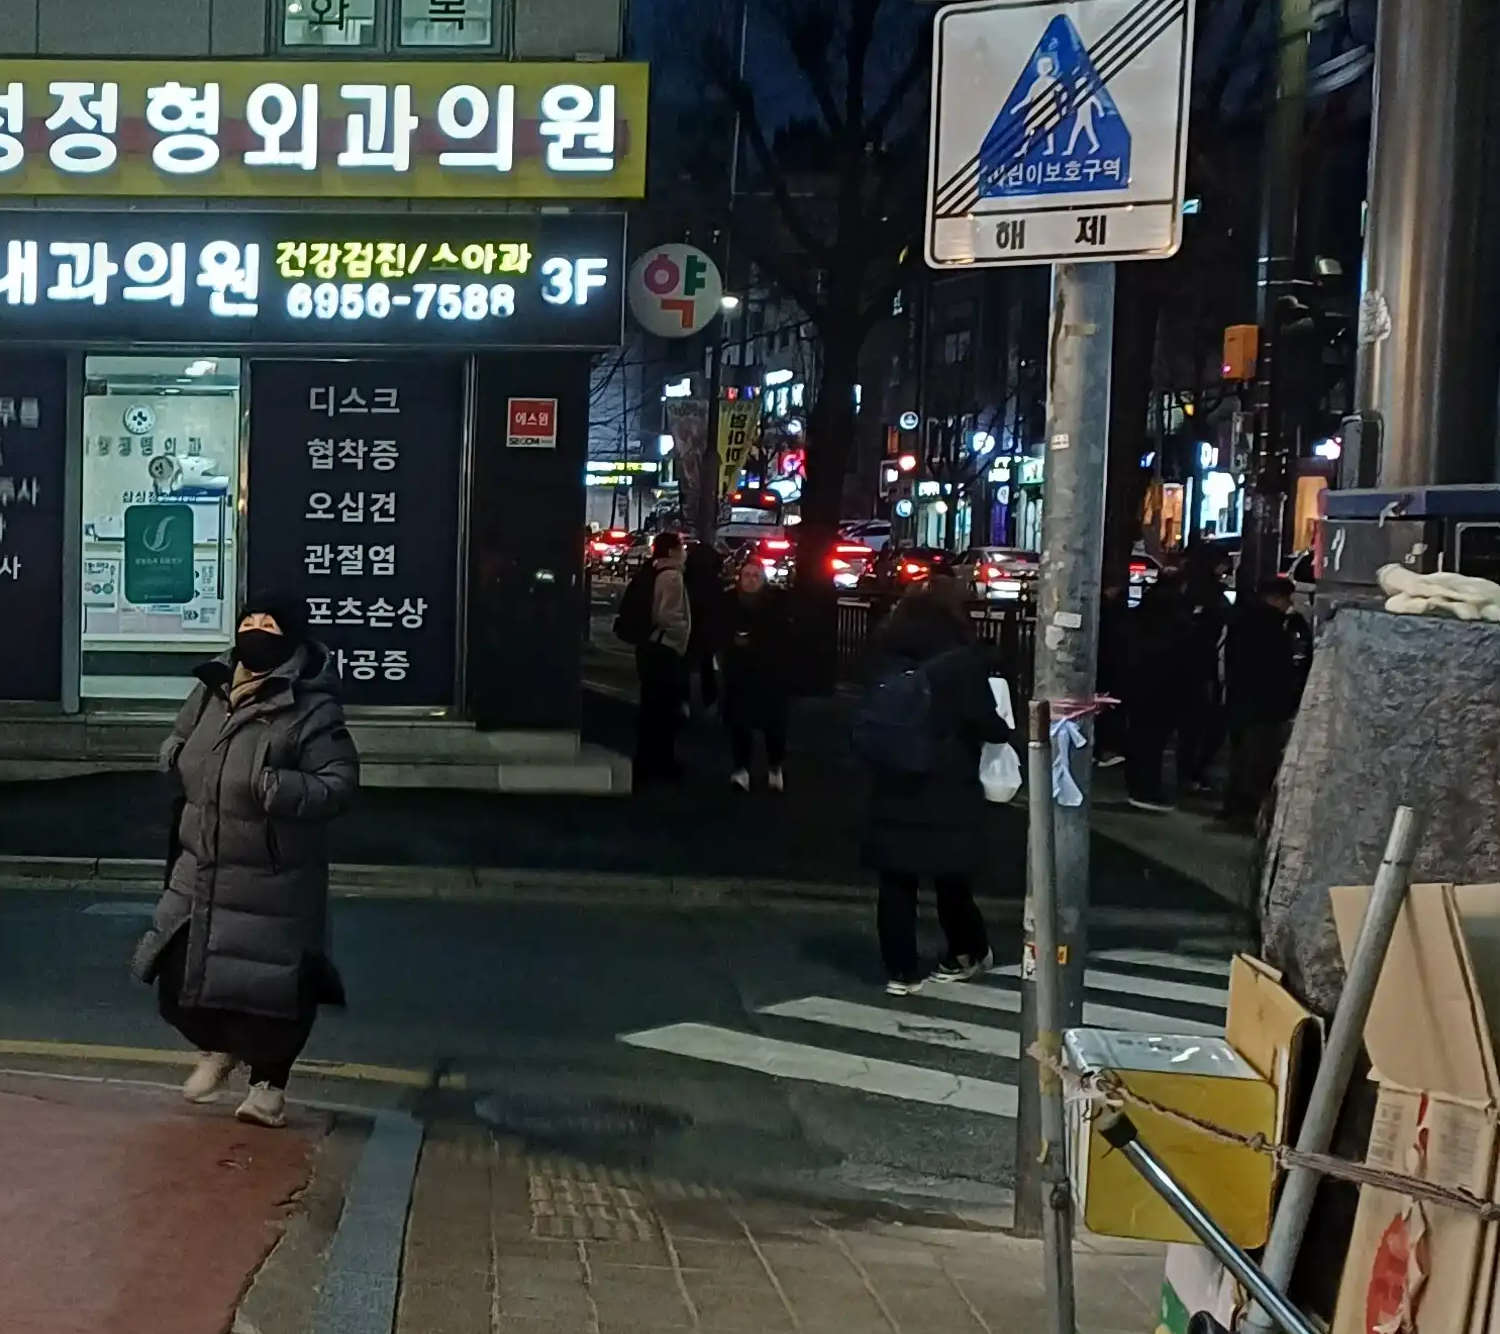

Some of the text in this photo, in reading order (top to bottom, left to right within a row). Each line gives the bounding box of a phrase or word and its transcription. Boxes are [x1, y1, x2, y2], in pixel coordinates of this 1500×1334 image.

[540, 256, 609, 306] 3F
[642, 252, 706, 329] 약
[308, 385, 401, 419] 디스크
[515, 410, 550, 427] 에스원
[306, 438, 401, 472] 협착증
[304, 491, 398, 524] 오십견
[303, 543, 397, 578] 관절염
